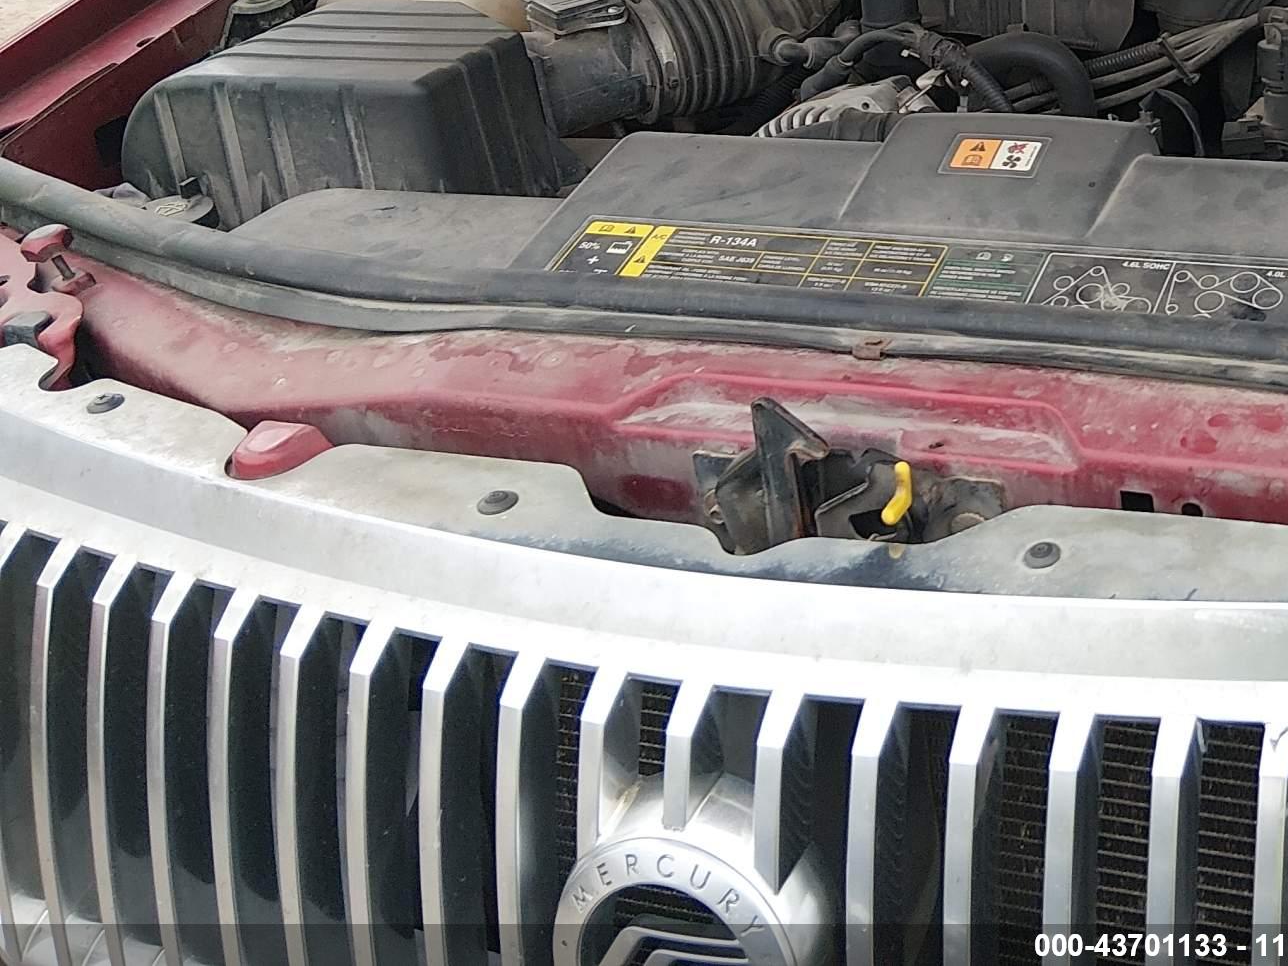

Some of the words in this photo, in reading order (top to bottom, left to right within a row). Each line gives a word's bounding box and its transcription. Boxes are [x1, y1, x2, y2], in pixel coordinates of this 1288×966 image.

[709, 235, 758, 247] R-134A
[1142, 263, 1171, 271] SOHC
[570, 853, 766, 938] MERCURY
